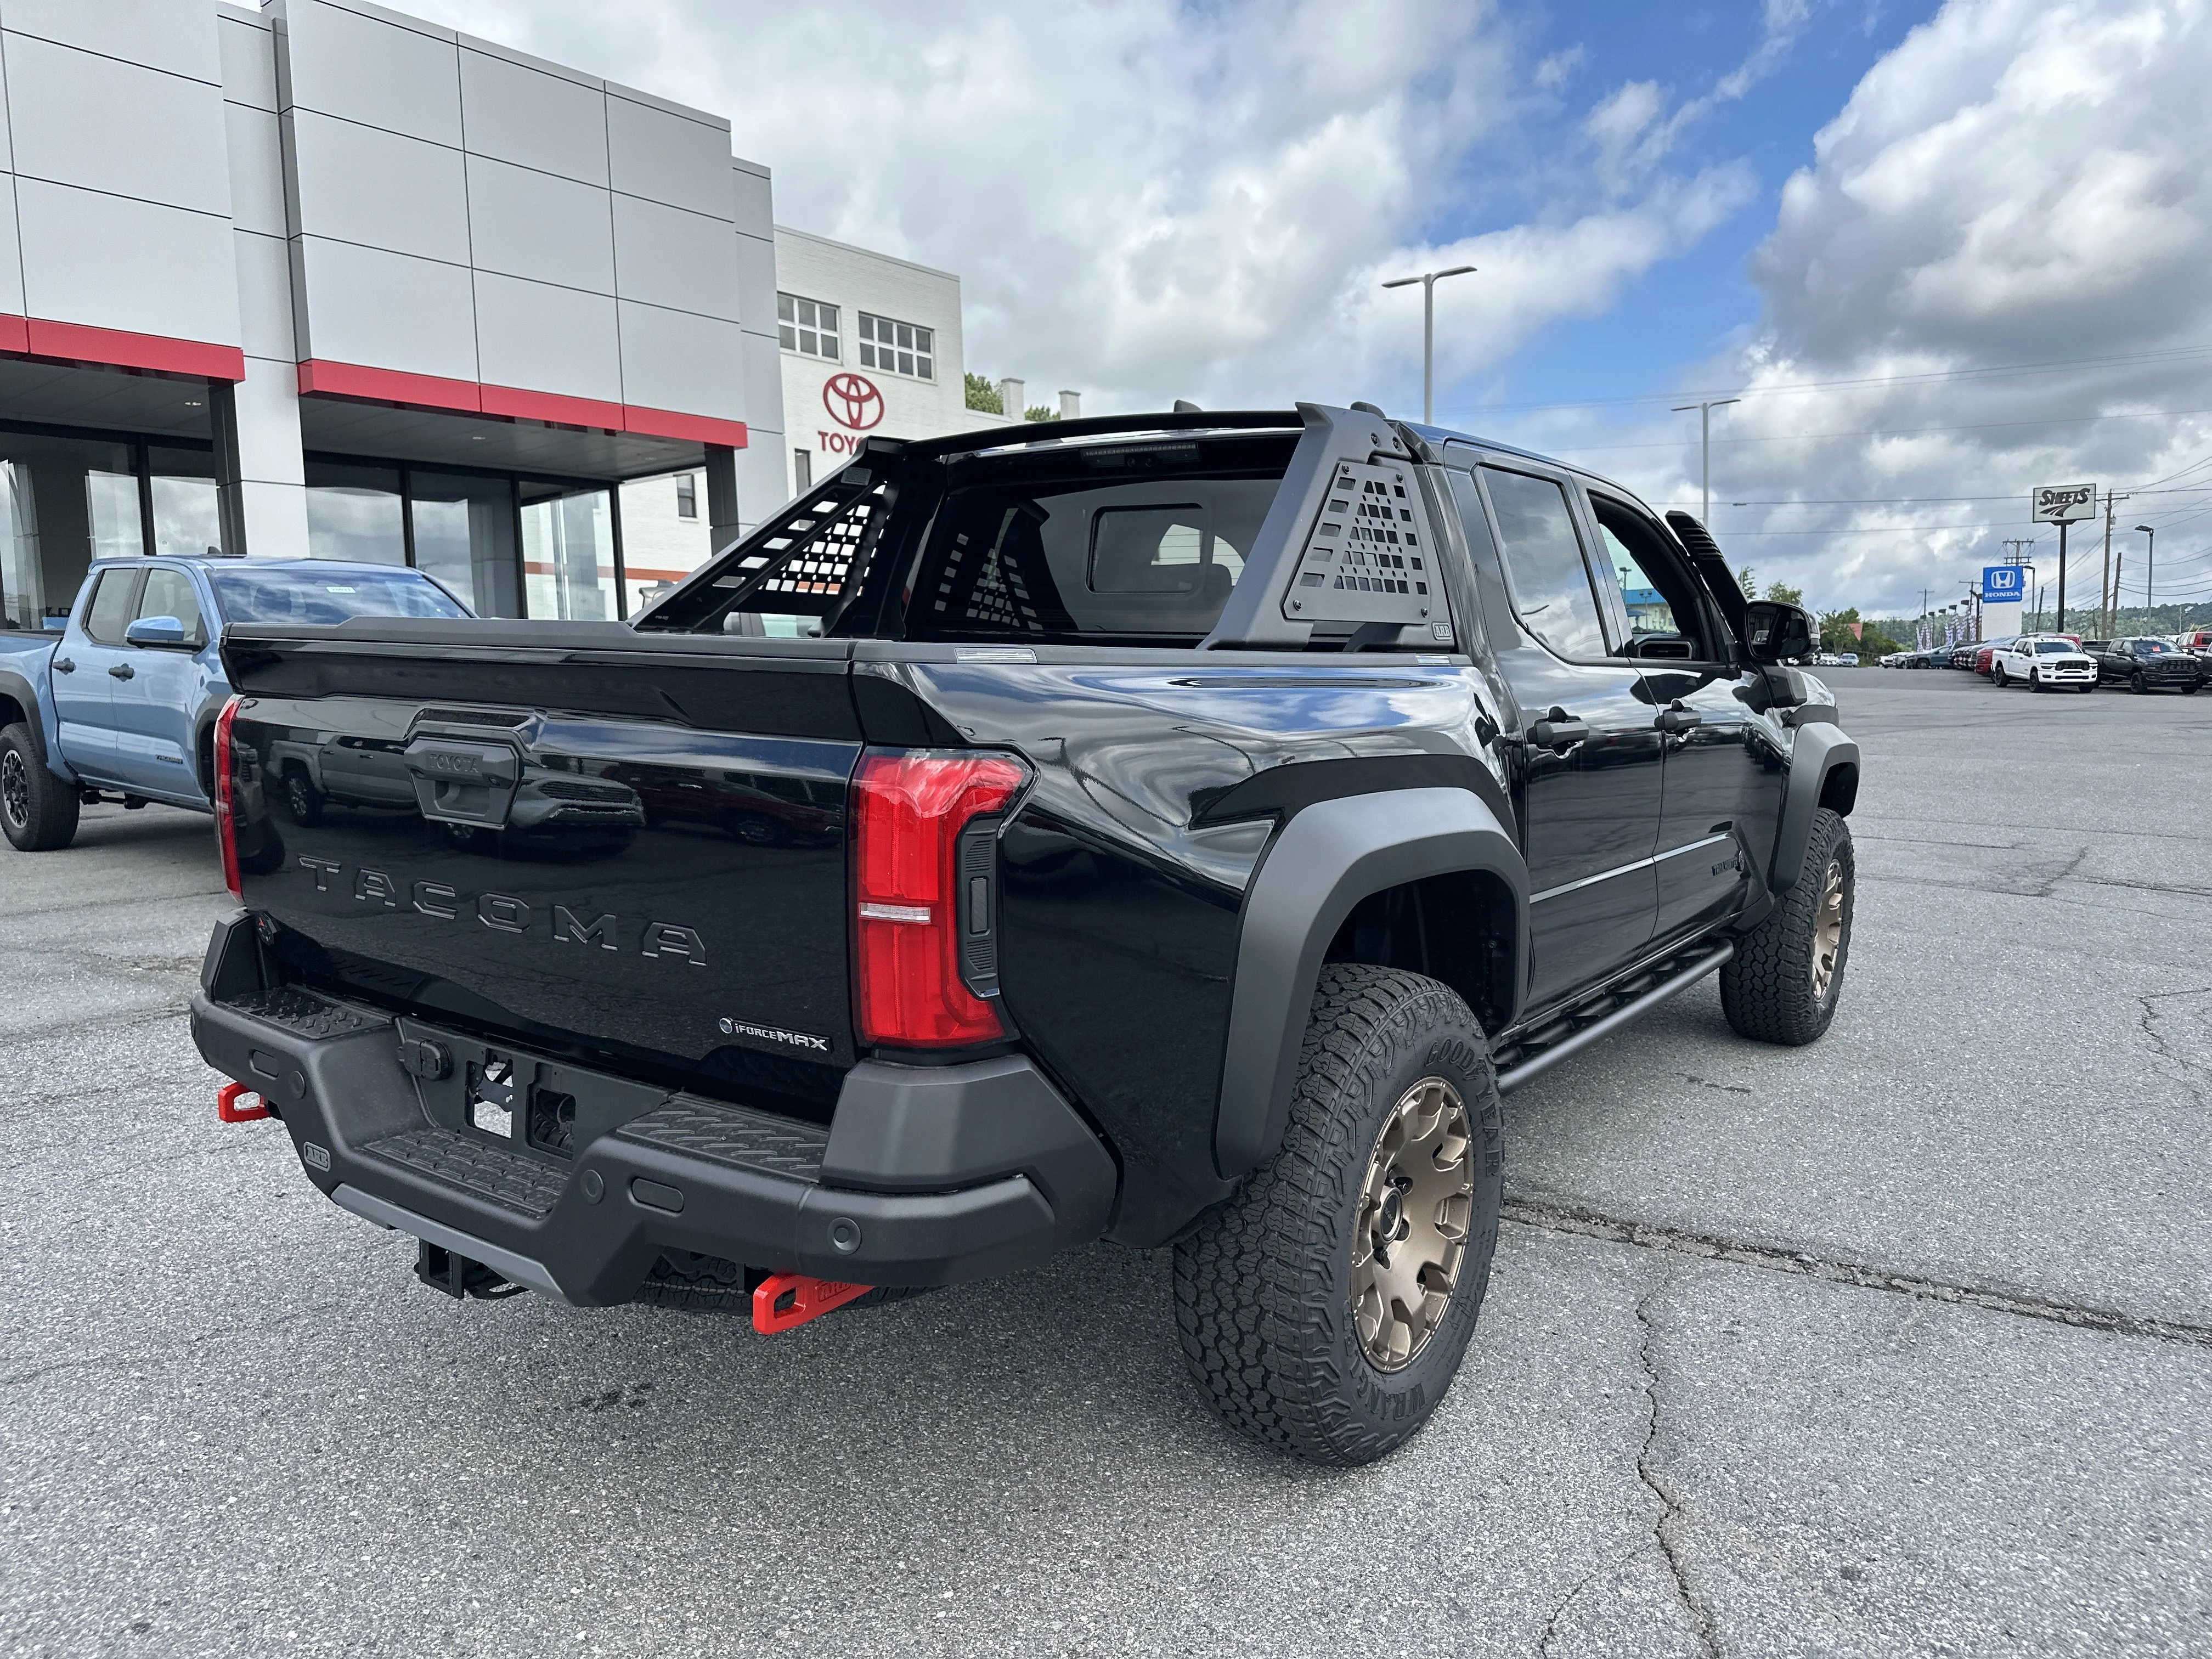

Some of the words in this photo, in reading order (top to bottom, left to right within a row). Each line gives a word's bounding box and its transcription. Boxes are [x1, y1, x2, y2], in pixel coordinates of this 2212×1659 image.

[818, 431, 864, 455] TOY
[1434, 624, 1451, 637] ARB
[430, 753, 479, 773] TOYOTA
[297, 854, 708, 967] TACOMA
